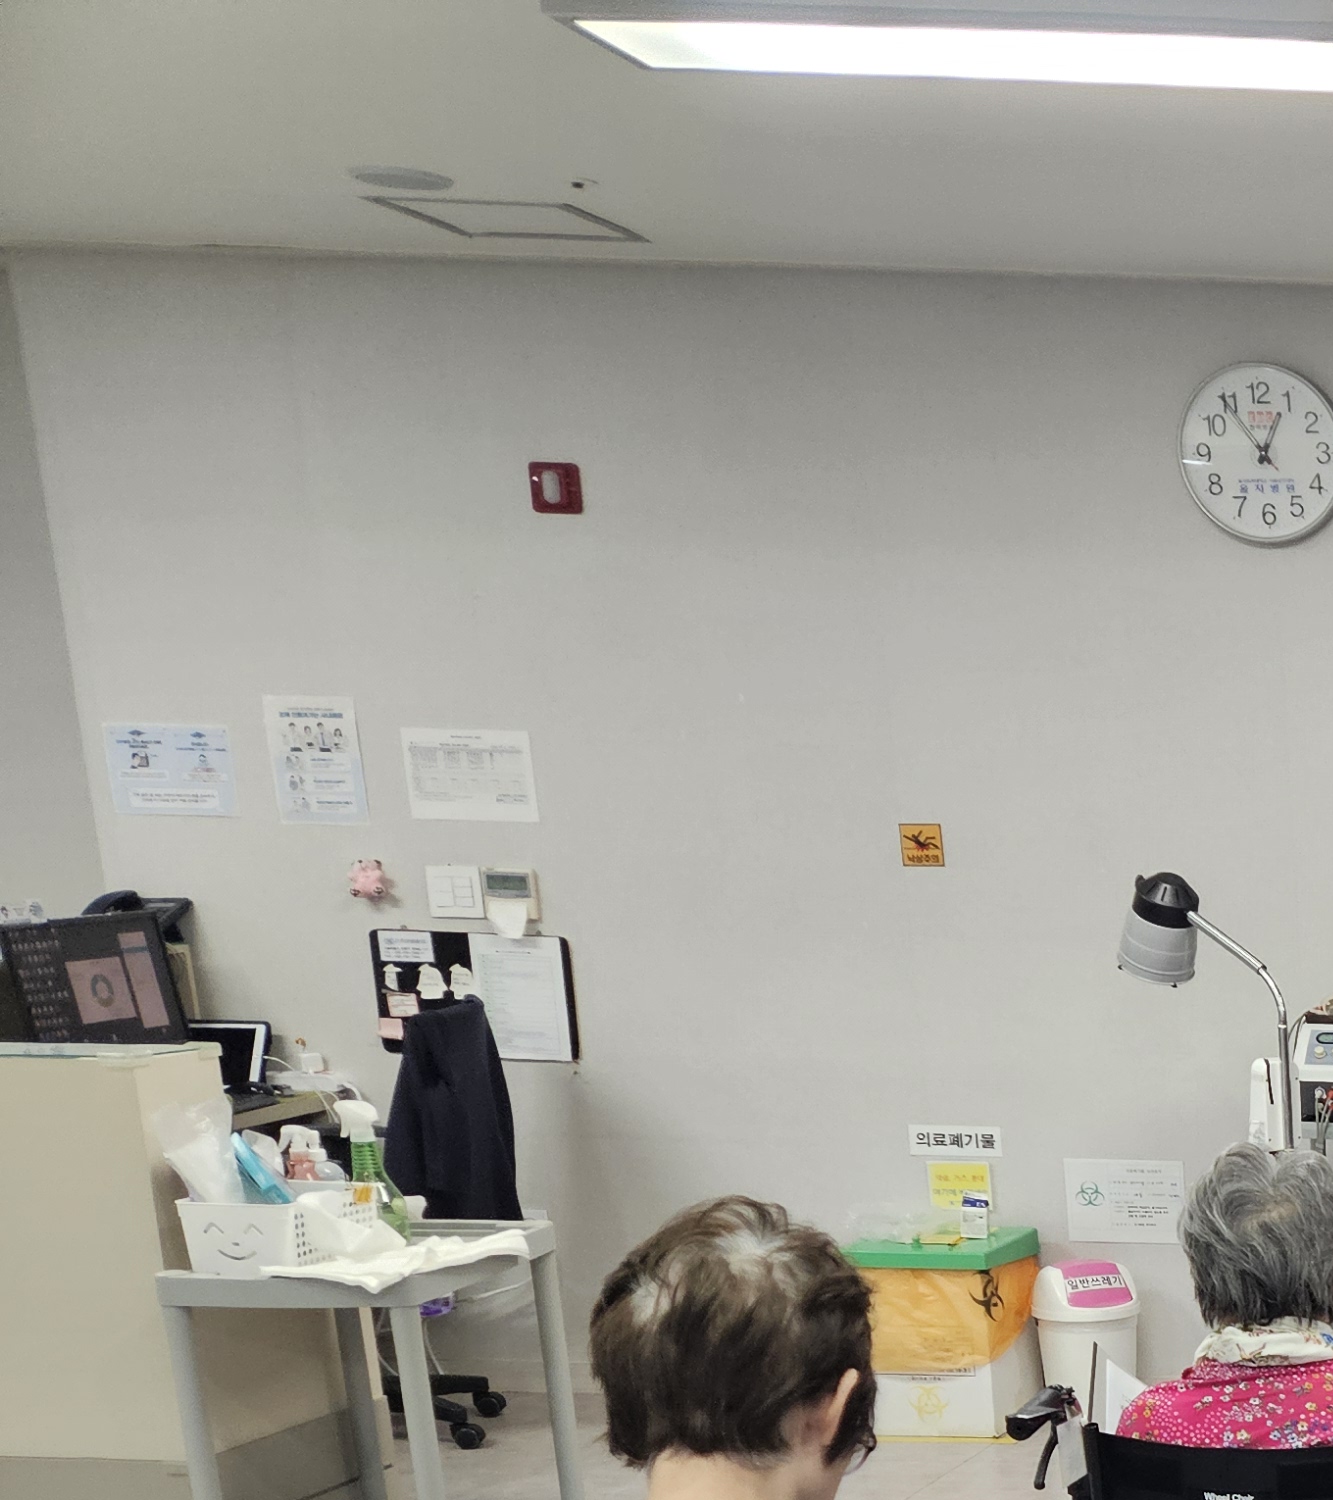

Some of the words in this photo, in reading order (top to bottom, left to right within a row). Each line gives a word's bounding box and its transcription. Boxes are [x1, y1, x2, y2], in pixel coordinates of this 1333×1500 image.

[1246, 382, 1271, 405] 12
[1281, 390, 1292, 412] 1
[1203, 414, 1226, 437] 10
[1305, 412, 1320, 434] 2
[1197, 443, 1211, 462] 9
[1316, 442, 1331, 464] 3
[1208, 473, 1223, 495] 8
[1309, 473, 1323, 495] 4
[1232, 496, 1247, 518] 7
[1262, 503, 1276, 526] 6
[1290, 496, 1305, 518] 5
[907, 854, 940, 863] 낙상주의
[916, 1132, 996, 1150] 의료폐기물
[1066, 1274, 1123, 1291] 일반쓰레기
